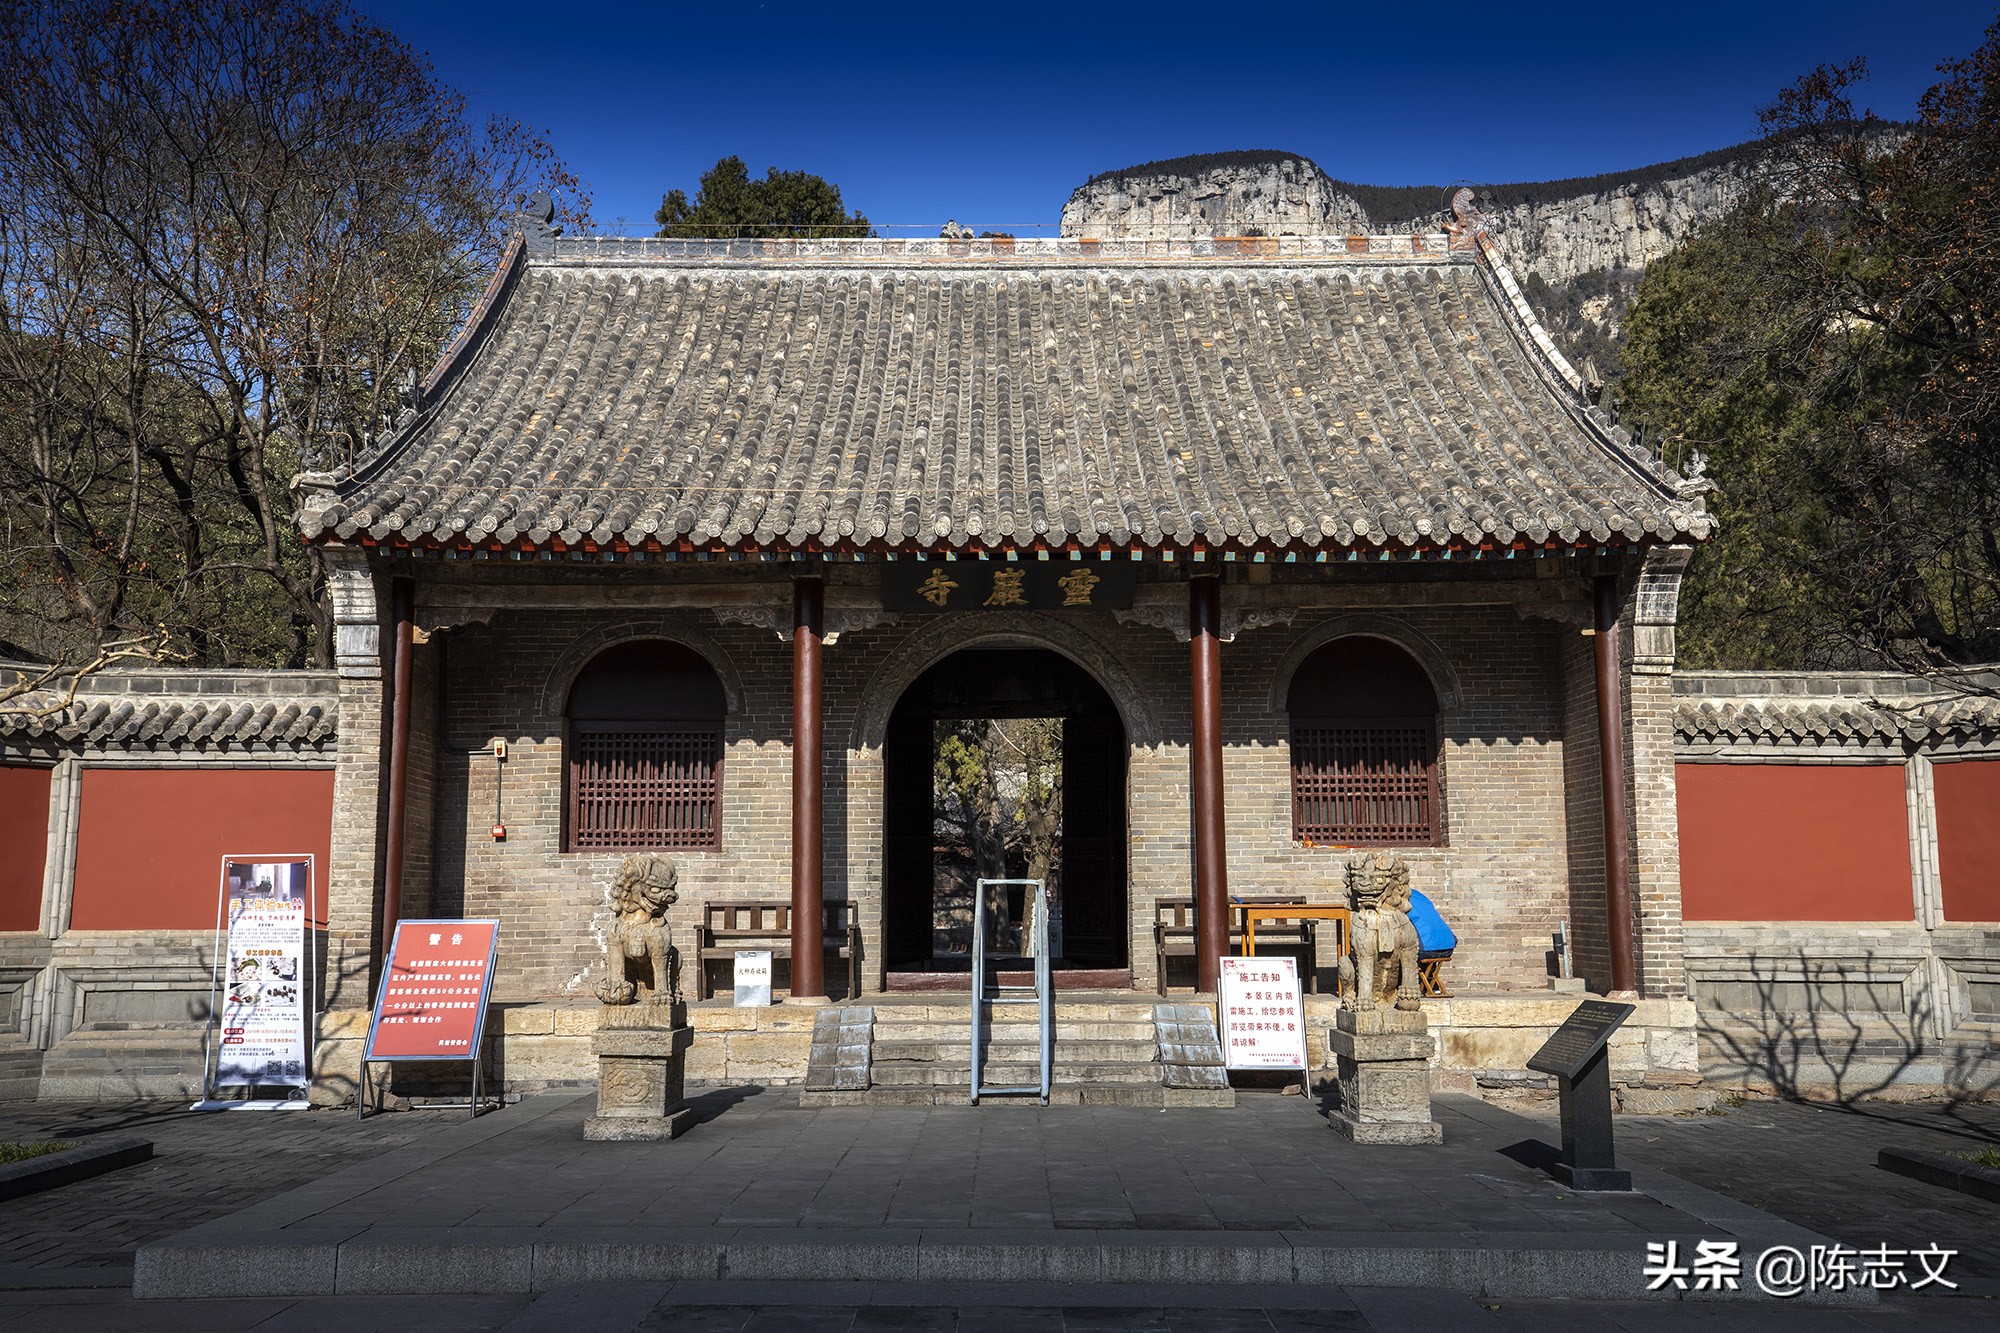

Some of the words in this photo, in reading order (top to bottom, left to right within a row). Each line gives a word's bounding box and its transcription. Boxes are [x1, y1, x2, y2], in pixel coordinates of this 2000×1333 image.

[429, 933, 463, 945] 警告
[1239, 972, 1281, 983] 施工告知
[1245, 992, 1293, 1000] 本景区内防
